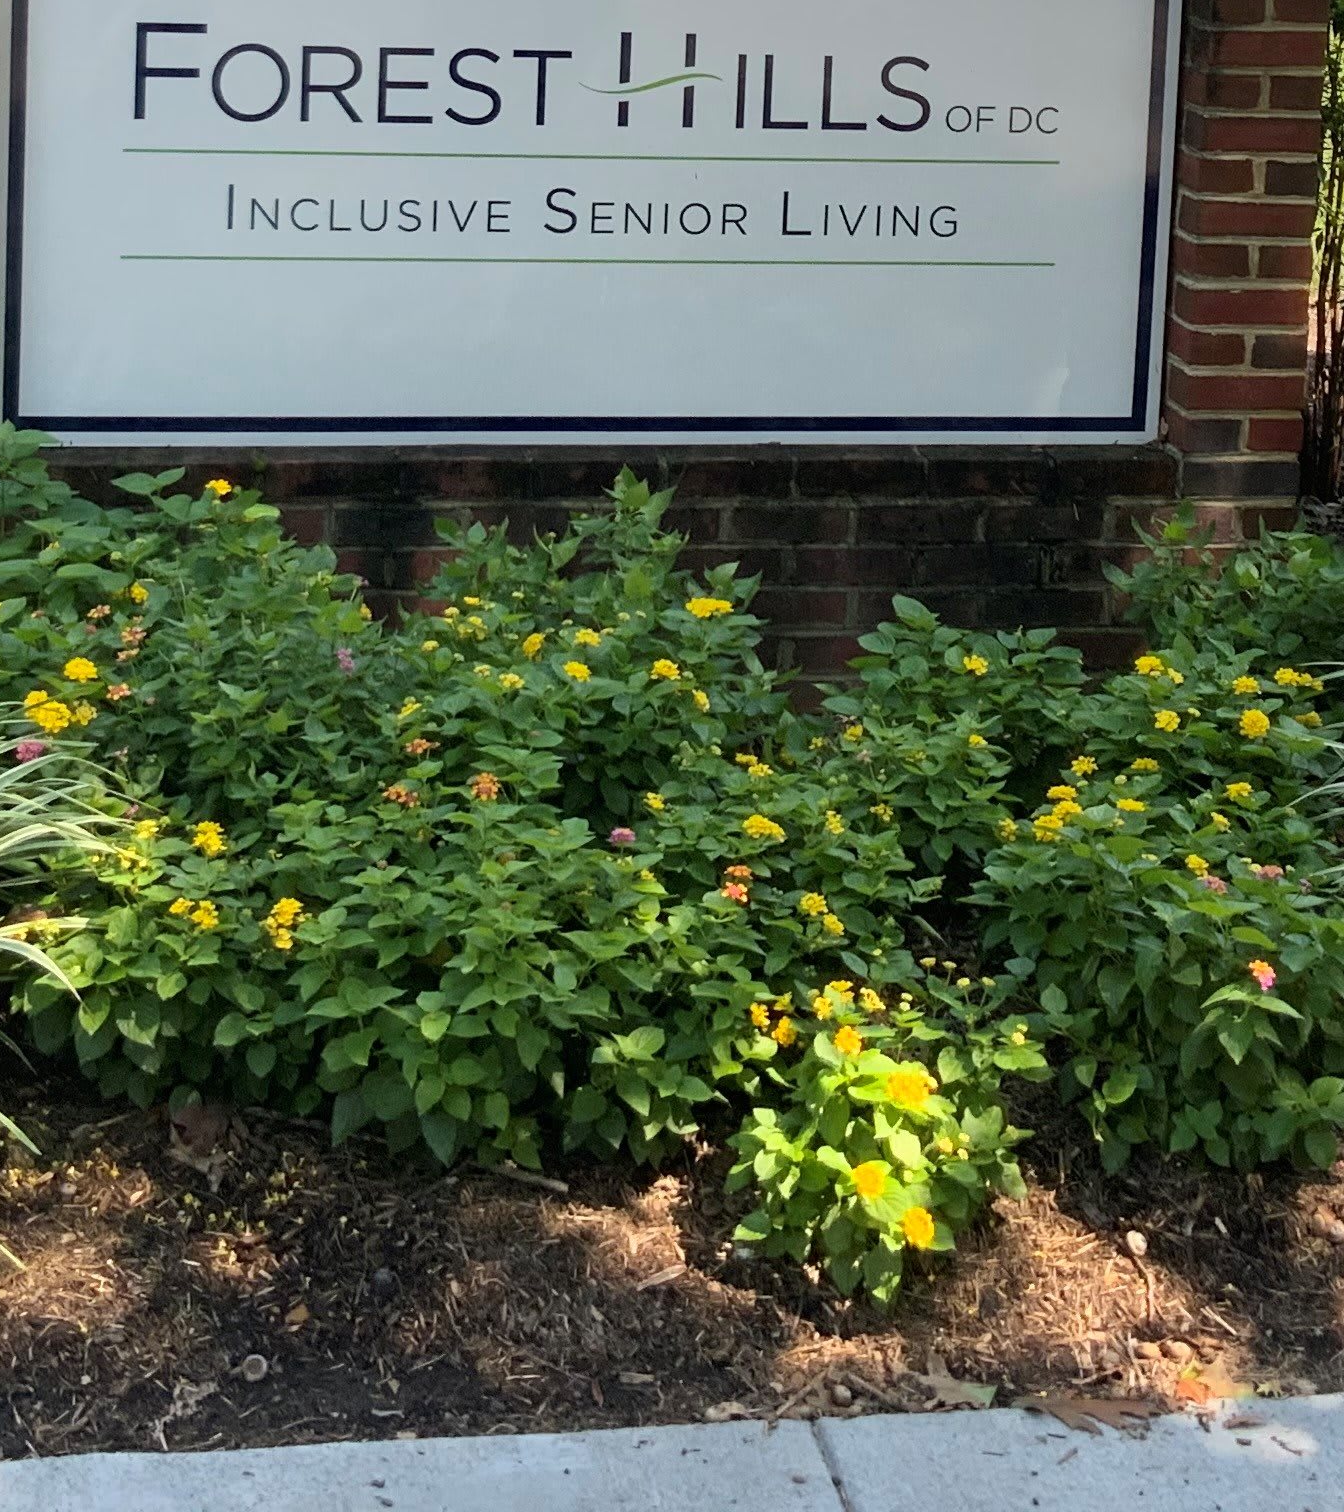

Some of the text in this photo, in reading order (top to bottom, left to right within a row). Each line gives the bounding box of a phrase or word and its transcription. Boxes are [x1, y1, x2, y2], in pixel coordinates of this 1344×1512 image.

[133, 22, 1060, 134] FOREST HILLS OF DC
[225, 183, 960, 239] INCLUSIVE SENIOR LIVING
